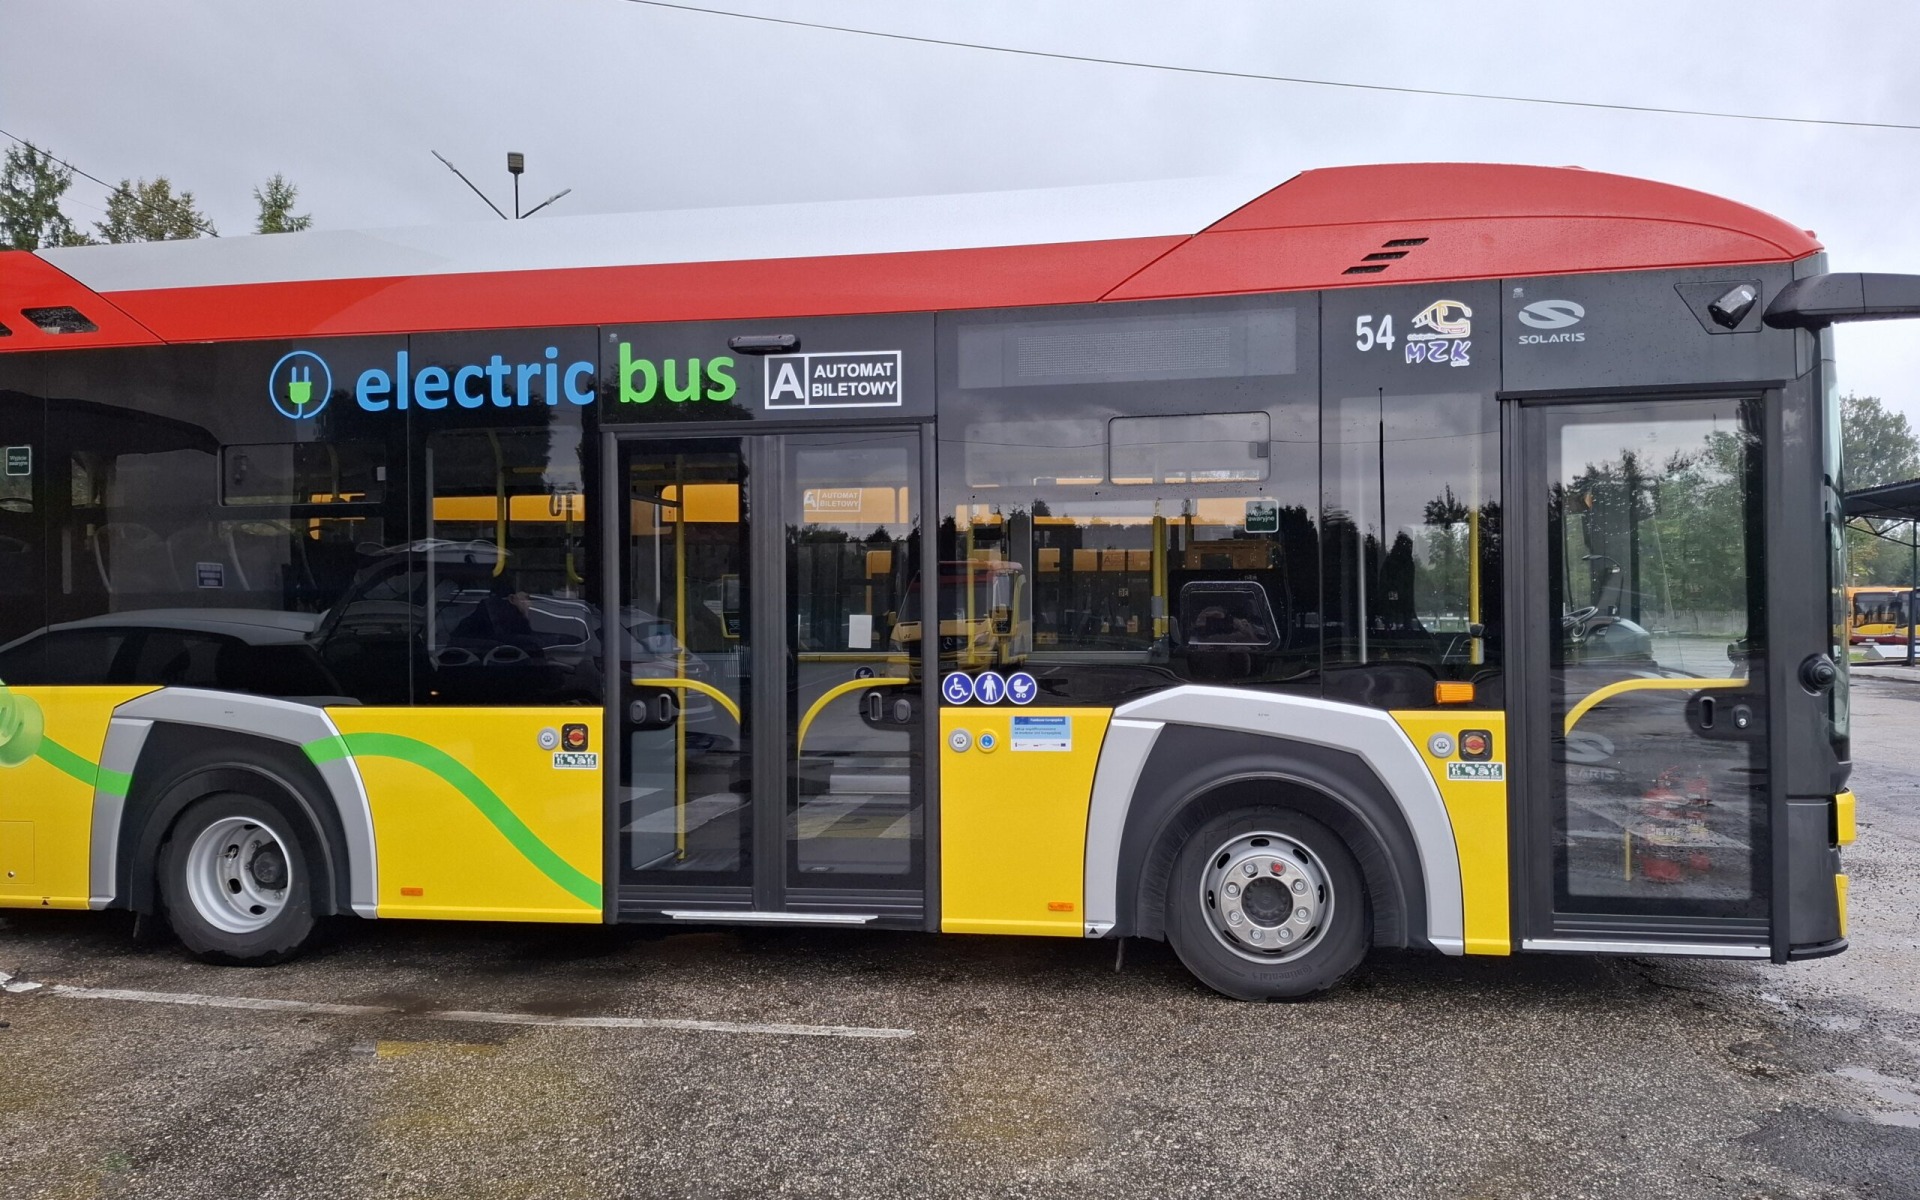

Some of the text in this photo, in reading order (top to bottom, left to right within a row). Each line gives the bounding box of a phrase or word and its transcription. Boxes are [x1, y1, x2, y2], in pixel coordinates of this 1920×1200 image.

[1355, 314, 1396, 352] 54
[1518, 333, 1585, 345] SOLARIS
[1405, 340, 1472, 364] MZK
[355, 342, 737, 412] electric bus
[813, 362, 894, 378] AUTOMAT
[770, 362, 805, 400] A
[811, 381, 897, 397] BILETOWY
[819, 500, 859, 508] BILETOWY
[1567, 768, 1615, 781] LARIS
